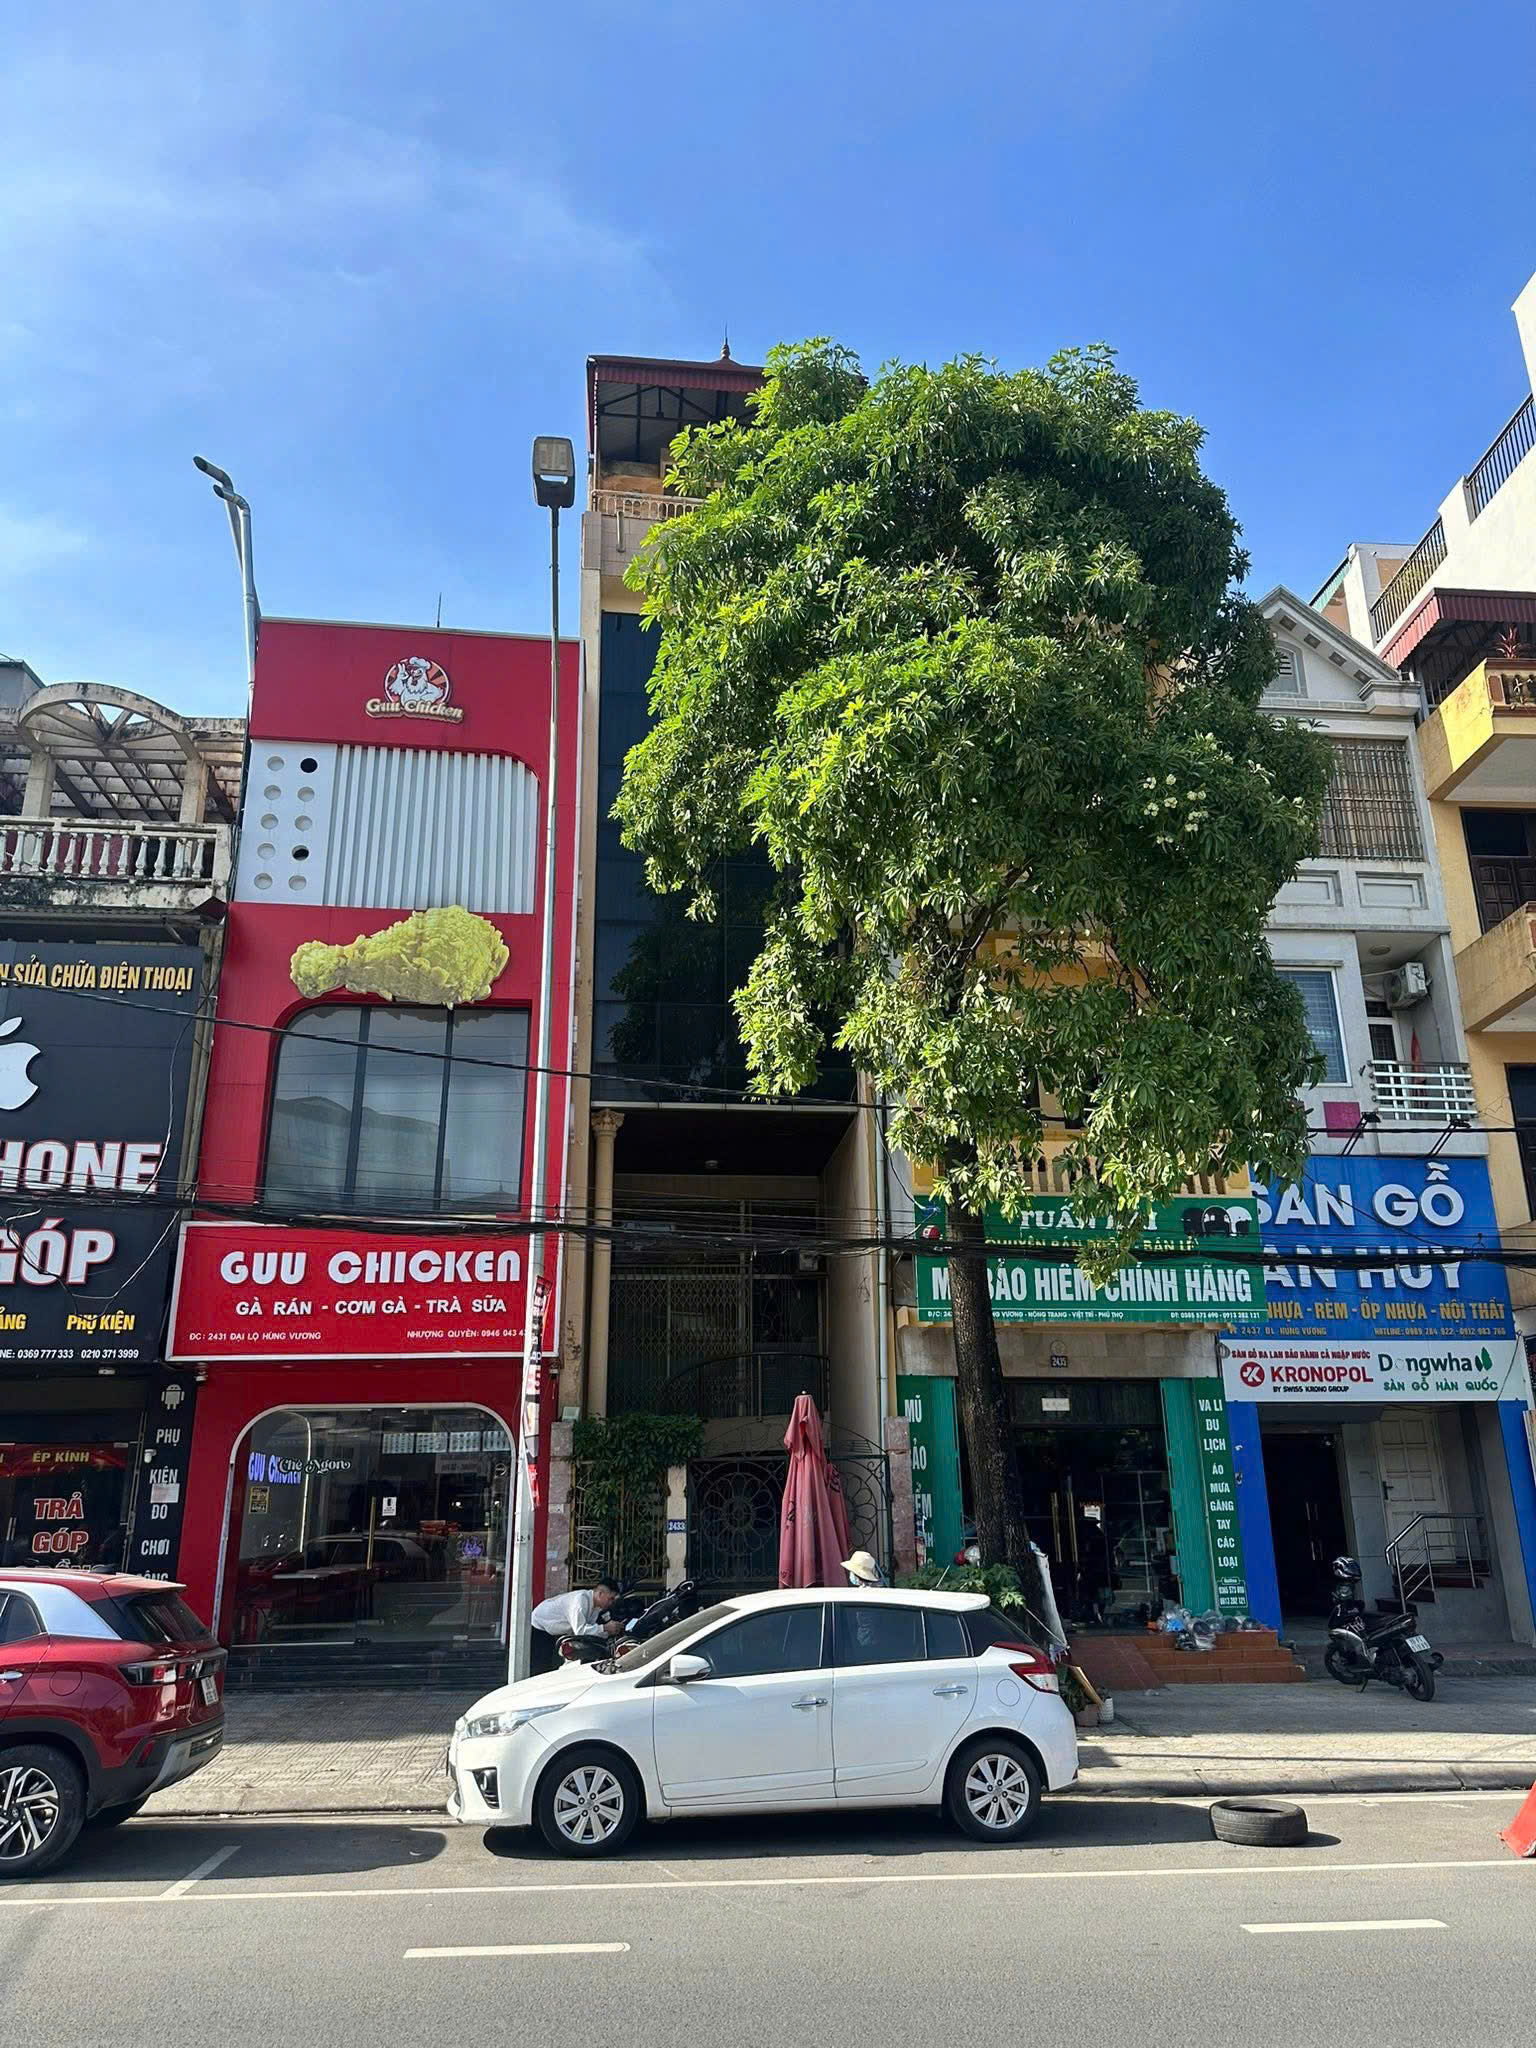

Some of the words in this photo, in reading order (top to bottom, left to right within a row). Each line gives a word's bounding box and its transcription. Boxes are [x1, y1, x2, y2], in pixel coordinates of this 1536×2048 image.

[402, 700, 463, 718] Chicken
[13, 954, 47, 985] SỬA
[51, 960, 96, 988] CHỮA
[100, 961, 140, 993] ĐIỆN
[144, 967, 193, 995] THOẠI
[1373, 1161, 1464, 1227] GỖ
[220, 1251, 306, 1285] GUU
[328, 1250, 520, 1284] CHICKEN
[1355, 1246, 1464, 1288] HUY
[1184, 1264, 1251, 1302] HÃNG
[235, 1297, 262, 1315] GÀ
[273, 1297, 312, 1315] RÁN
[334, 1300, 376, 1314] CƠM
[381, 1296, 407, 1313] GÀ
[426, 1296, 461, 1313] TRÀ
[471, 1294, 507, 1313] SỮA
[1314, 1299, 1348, 1319] RÈM
[1360, 1296, 1380, 1319] ỐP
[1385, 1301, 1427, 1322] NHỰA
[1440, 1299, 1466, 1322] NỘI
[1470, 1297, 1505, 1320] THẤT
[66, 1314, 97, 1334] PHỤ
[99, 1310, 136, 1334] KIỆN
[207, 1332, 227, 1340] 2431
[229, 1332, 245, 1342] ĐẠI
[289, 1331, 321, 1340] VƯƠNG
[407, 1330, 444, 1339] NHƯỢNG
[503, 1329, 517, 1337] 043
[17, 1349, 39, 1358] 0369
[40, 1349, 56, 1358] 777
[57, 1349, 74, 1358] 333
[81, 1349, 100, 1358] 0210
[102, 1349, 116, 1358] 371
[118, 1349, 139, 1358] 3999
[1270, 1366, 1373, 1382] KRONOPOL
[1384, 1378, 1405, 1391] SÀN
[1412, 1377, 1429, 1391] GỖ
[1436, 1378, 1458, 1391] HÀN
[1466, 1376, 1498, 1391] QUỐC
[1199, 1400, 1211, 1411] VA
[1213, 1400, 1223, 1411] LI
[1206, 1419, 1219, 1431] DU
[156, 1429, 181, 1447] PHỤ
[1204, 1438, 1226, 1453] LỊCH
[55, 1450, 90, 1462] KÍNH
[912, 1438, 927, 1470] ẢO
[248, 1452, 266, 1482] GUU
[1212, 1463, 1224, 1475] ÁO
[1210, 1482, 1230, 1493] MƯA
[34, 1491, 84, 1519] TRẢ
[1216, 1519, 1231, 1529] TAY
[32, 1527, 88, 1553] GÓP
[141, 1538, 170, 1555] CHƠI
[1217, 1536, 1235, 1548] CÁC
[1218, 1556, 1238, 1569] LOẠI
